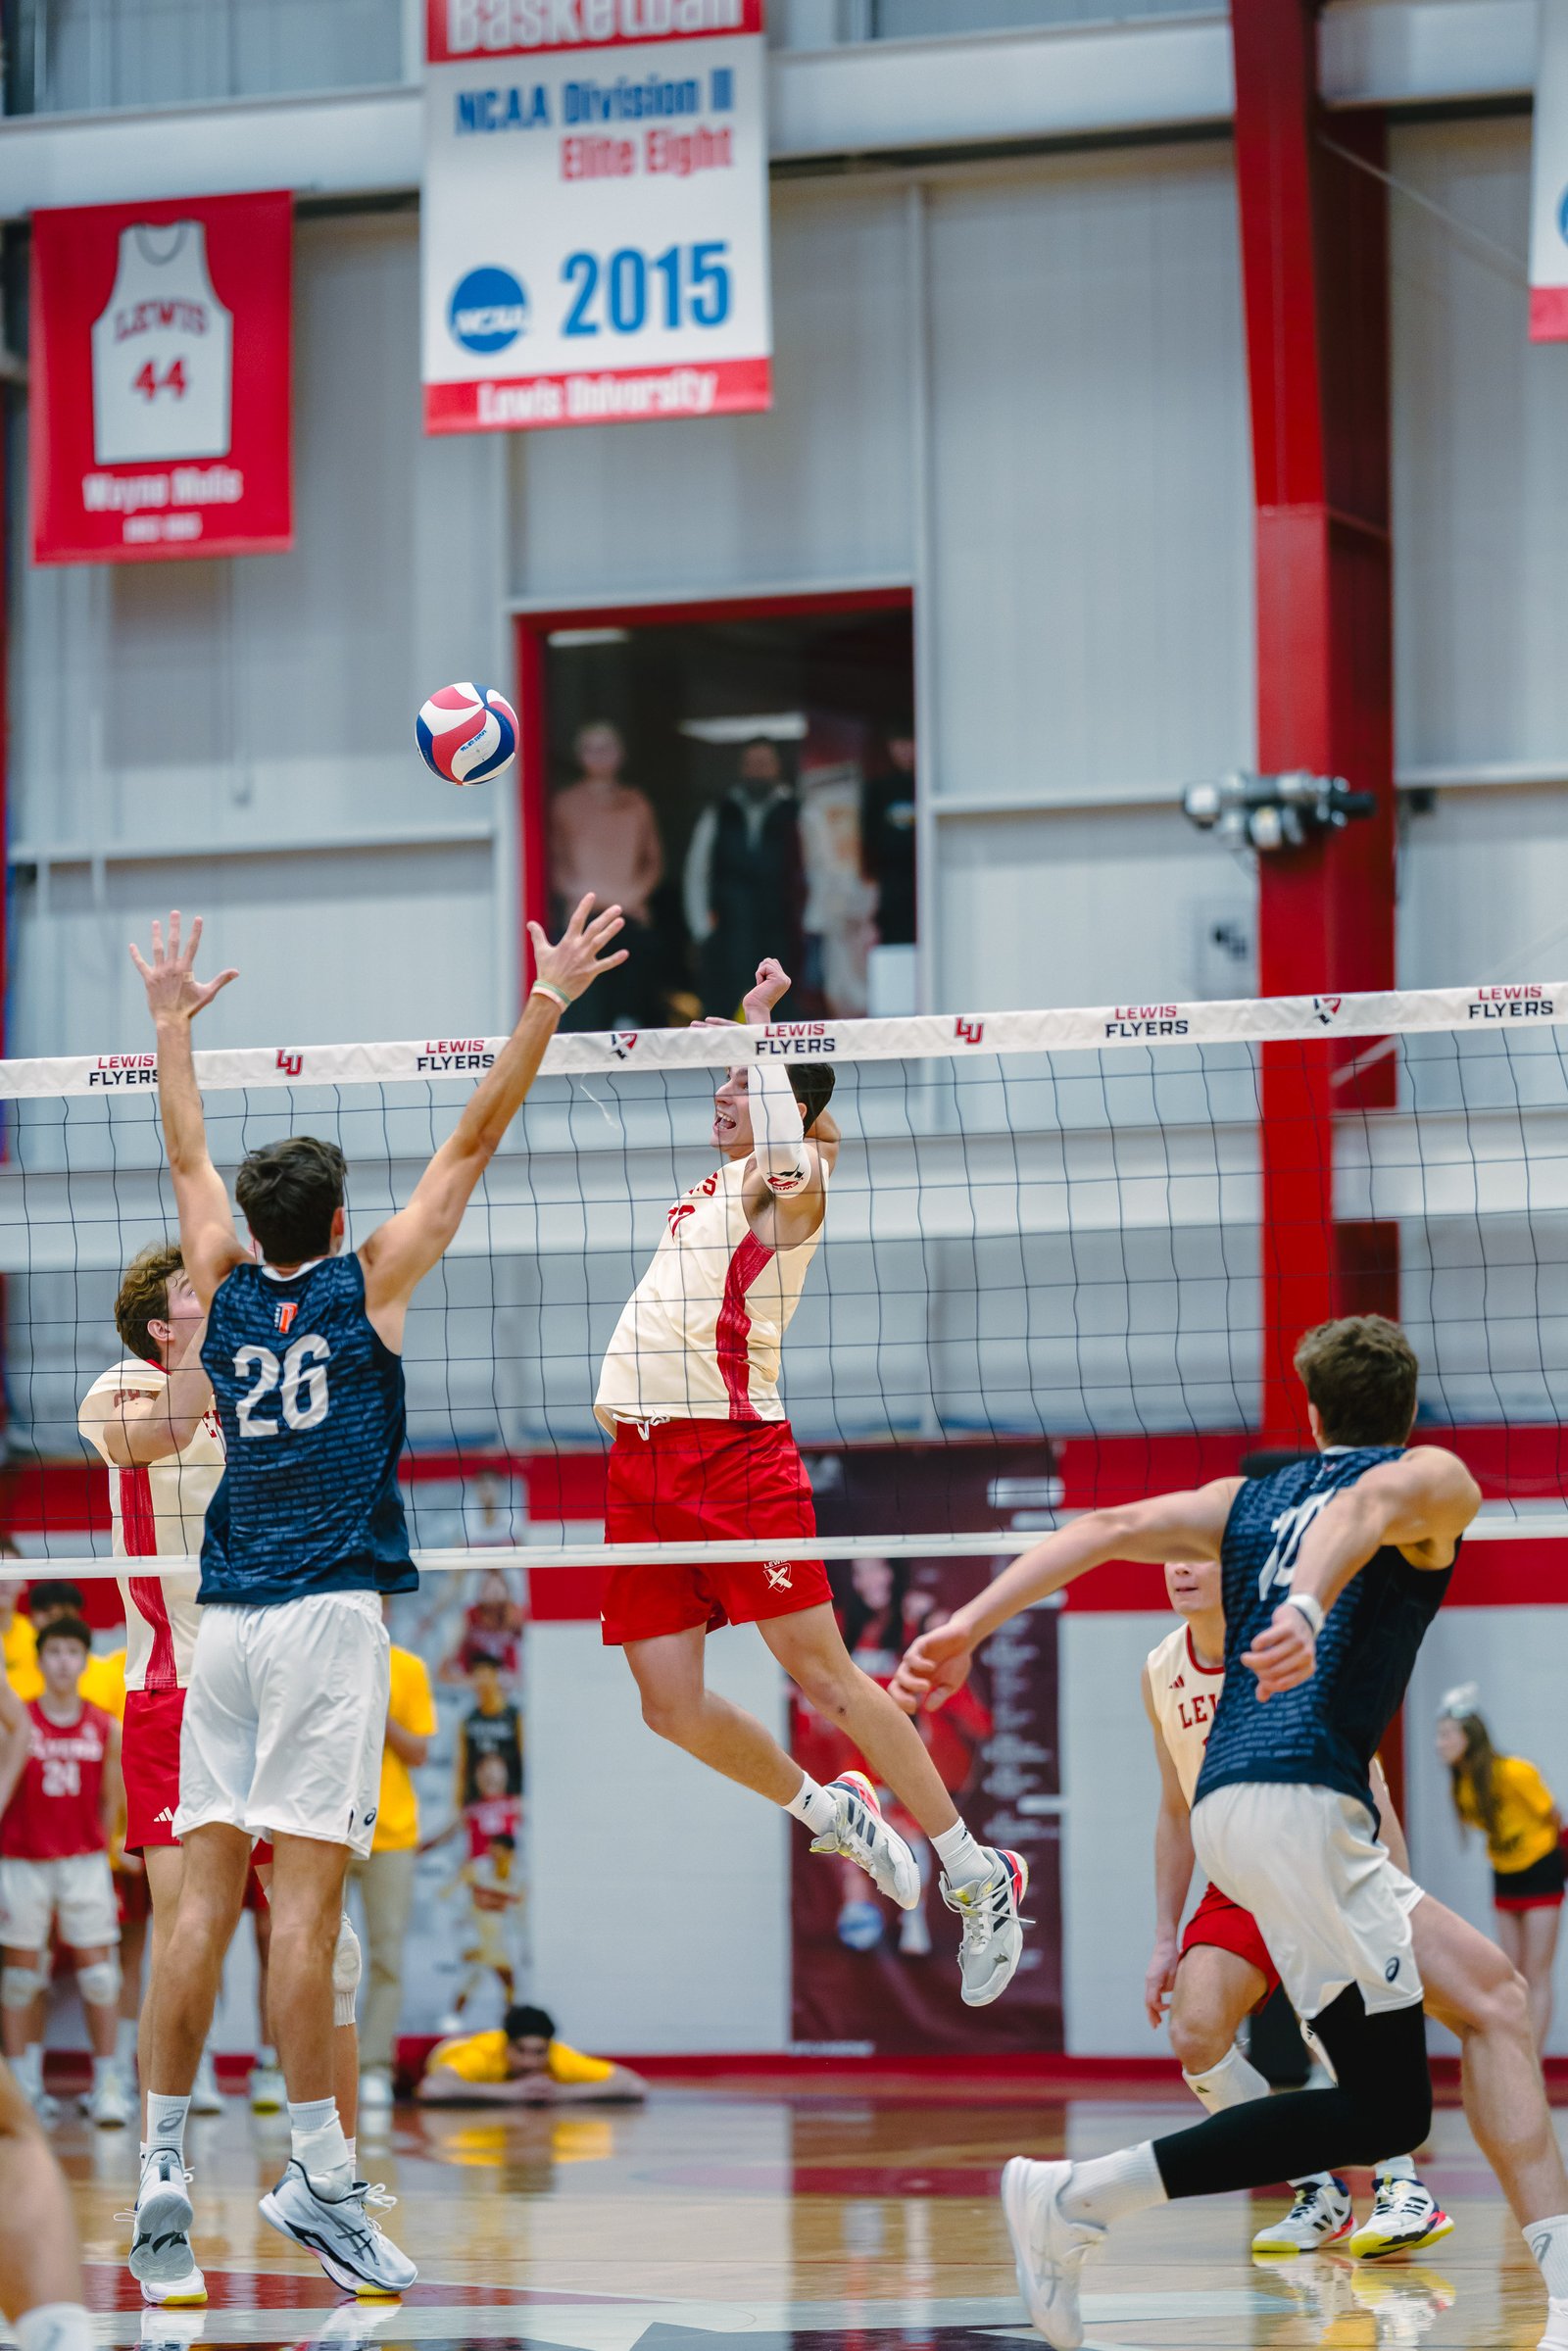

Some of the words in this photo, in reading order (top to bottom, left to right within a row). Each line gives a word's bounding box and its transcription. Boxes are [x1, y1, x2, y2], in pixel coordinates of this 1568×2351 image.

[456, 88, 551, 134] NCAA
[563, 75, 699, 125] Division
[562, 135, 633, 180] Elite
[646, 125, 732, 177] Eight
[562, 241, 731, 338] 2015
[115, 300, 209, 341] LEWIS
[133, 358, 189, 400] 44
[477, 379, 564, 425] Lewis
[565, 366, 718, 416] University
[1478, 985, 1544, 1001] LEWIS
[1114, 1004, 1178, 1020] LEWIS
[1468, 1001, 1554, 1020] FLYERS
[764, 1023, 825, 1039] LEWIS
[1104, 1020, 1189, 1039] FLYERS
[425, 1039, 485, 1054] LEWIS
[755, 1038, 836, 1055] FLYERS
[98, 1054, 155, 1069] LEWIS
[416, 1053, 495, 1072] FLYERS
[89, 1069, 159, 1087] FLYERS
[232, 1334, 331, 1438] 26
